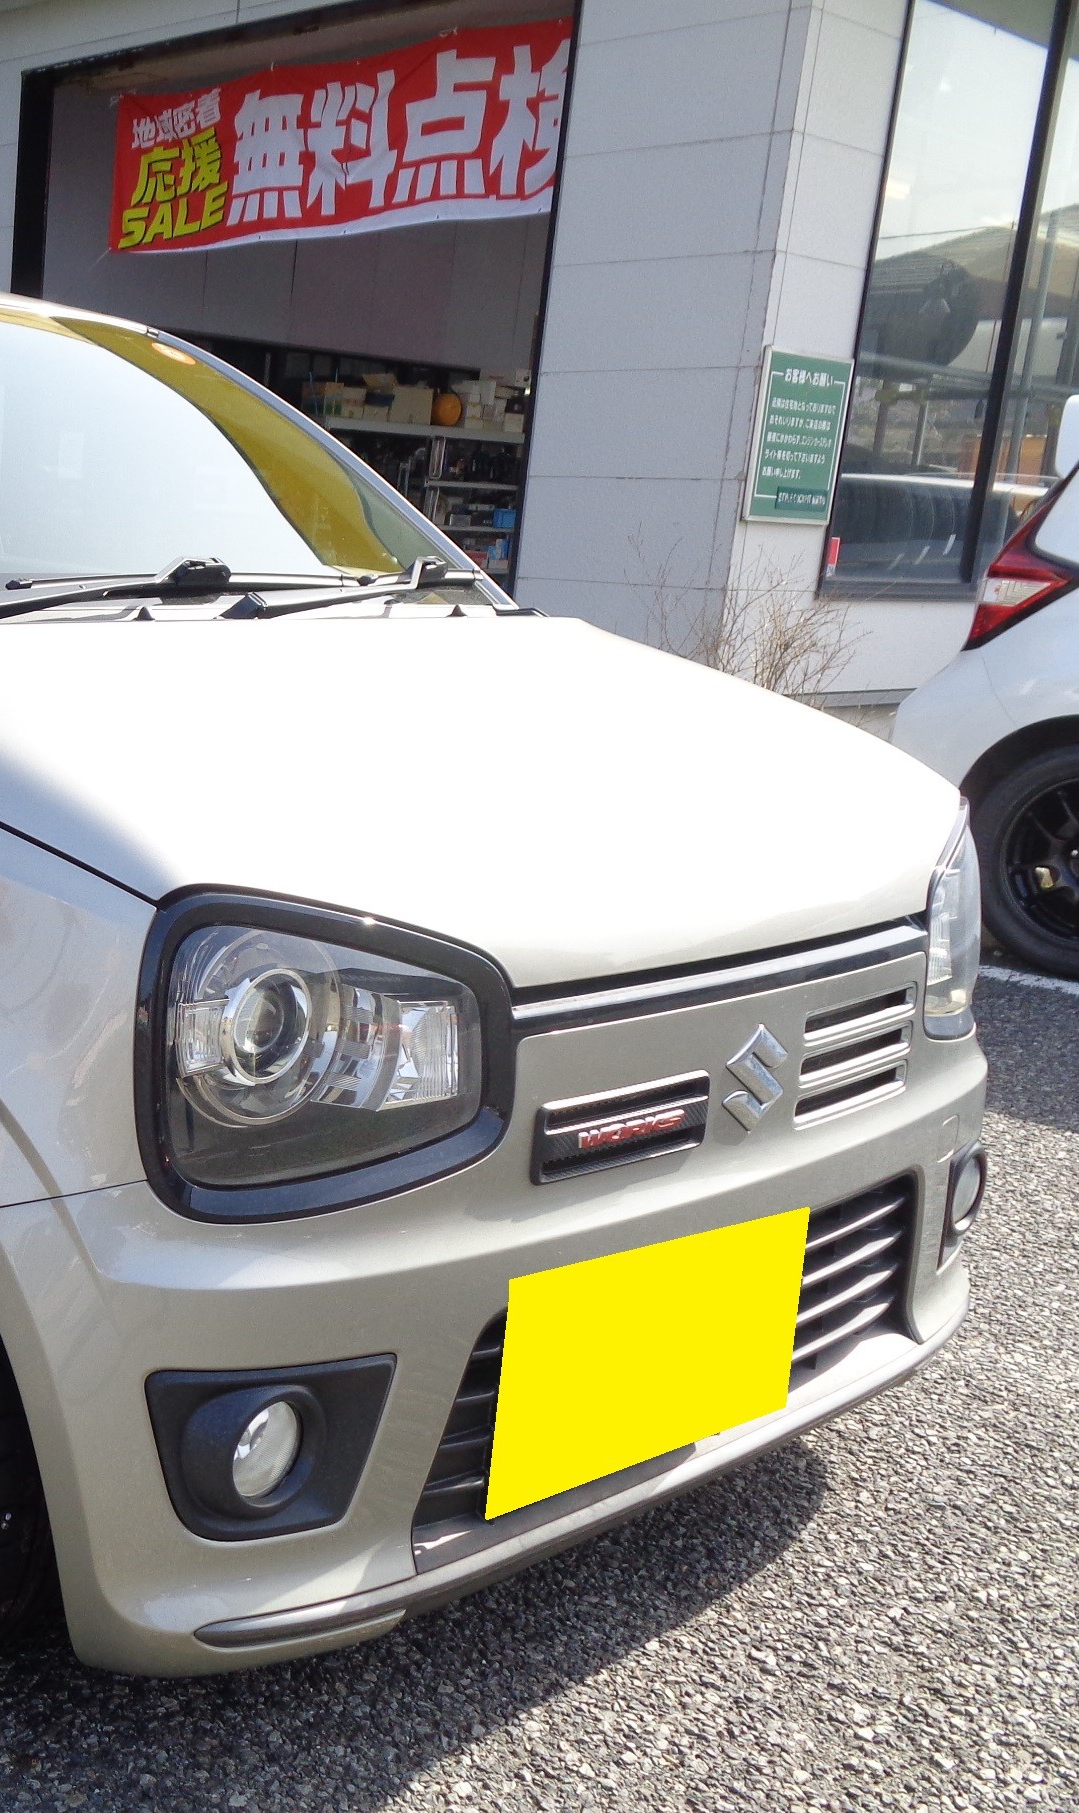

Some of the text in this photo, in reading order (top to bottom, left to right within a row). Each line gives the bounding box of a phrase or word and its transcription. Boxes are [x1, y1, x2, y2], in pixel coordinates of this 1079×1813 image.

[132, 88, 221, 149] 地域密着
[131, 127, 221, 206] 応援
[118, 181, 228, 249] SALE
[784, 367, 834, 388] お客様へお願い
